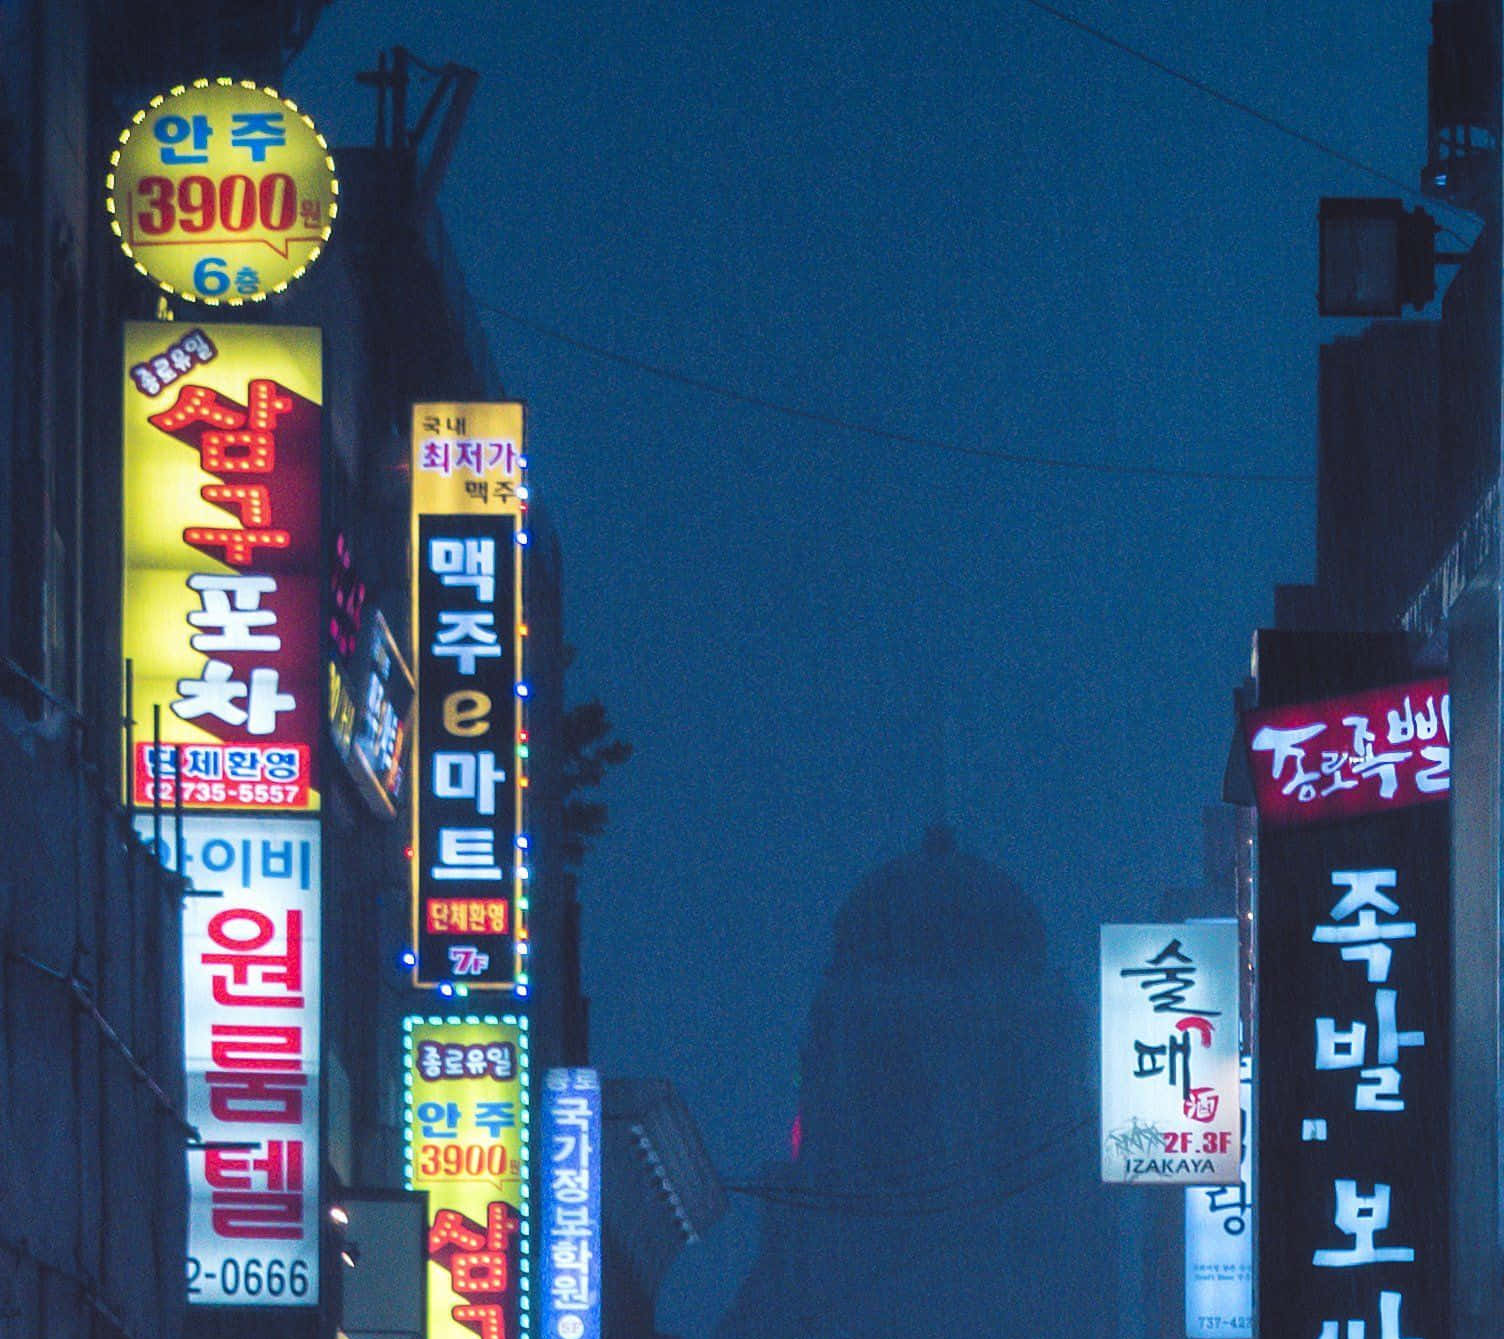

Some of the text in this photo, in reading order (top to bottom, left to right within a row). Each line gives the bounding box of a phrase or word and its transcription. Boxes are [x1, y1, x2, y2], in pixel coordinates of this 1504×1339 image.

[153, 111, 288, 166] 안주
[136, 172, 324, 238] 3900원
[193, 256, 263, 296] 6층
[131, 327, 218, 398] 종로유일
[421, 416, 467, 436] 국내
[421, 442, 517, 473] 최저가
[465, 479, 516, 504] 맥주
[147, 378, 297, 736] 삼구포차
[429, 537, 506, 881] 맥주e마트
[144, 744, 300, 783] 단체환영
[429, 901, 506, 933] 단체환영
[447, 945, 490, 975] 7F
[200, 907, 309, 1241] 원룸텔
[419, 1043, 514, 1078] 종로유일
[416, 1101, 516, 1139] 안주
[1125, 1157, 1216, 1176] IZAKAYA
